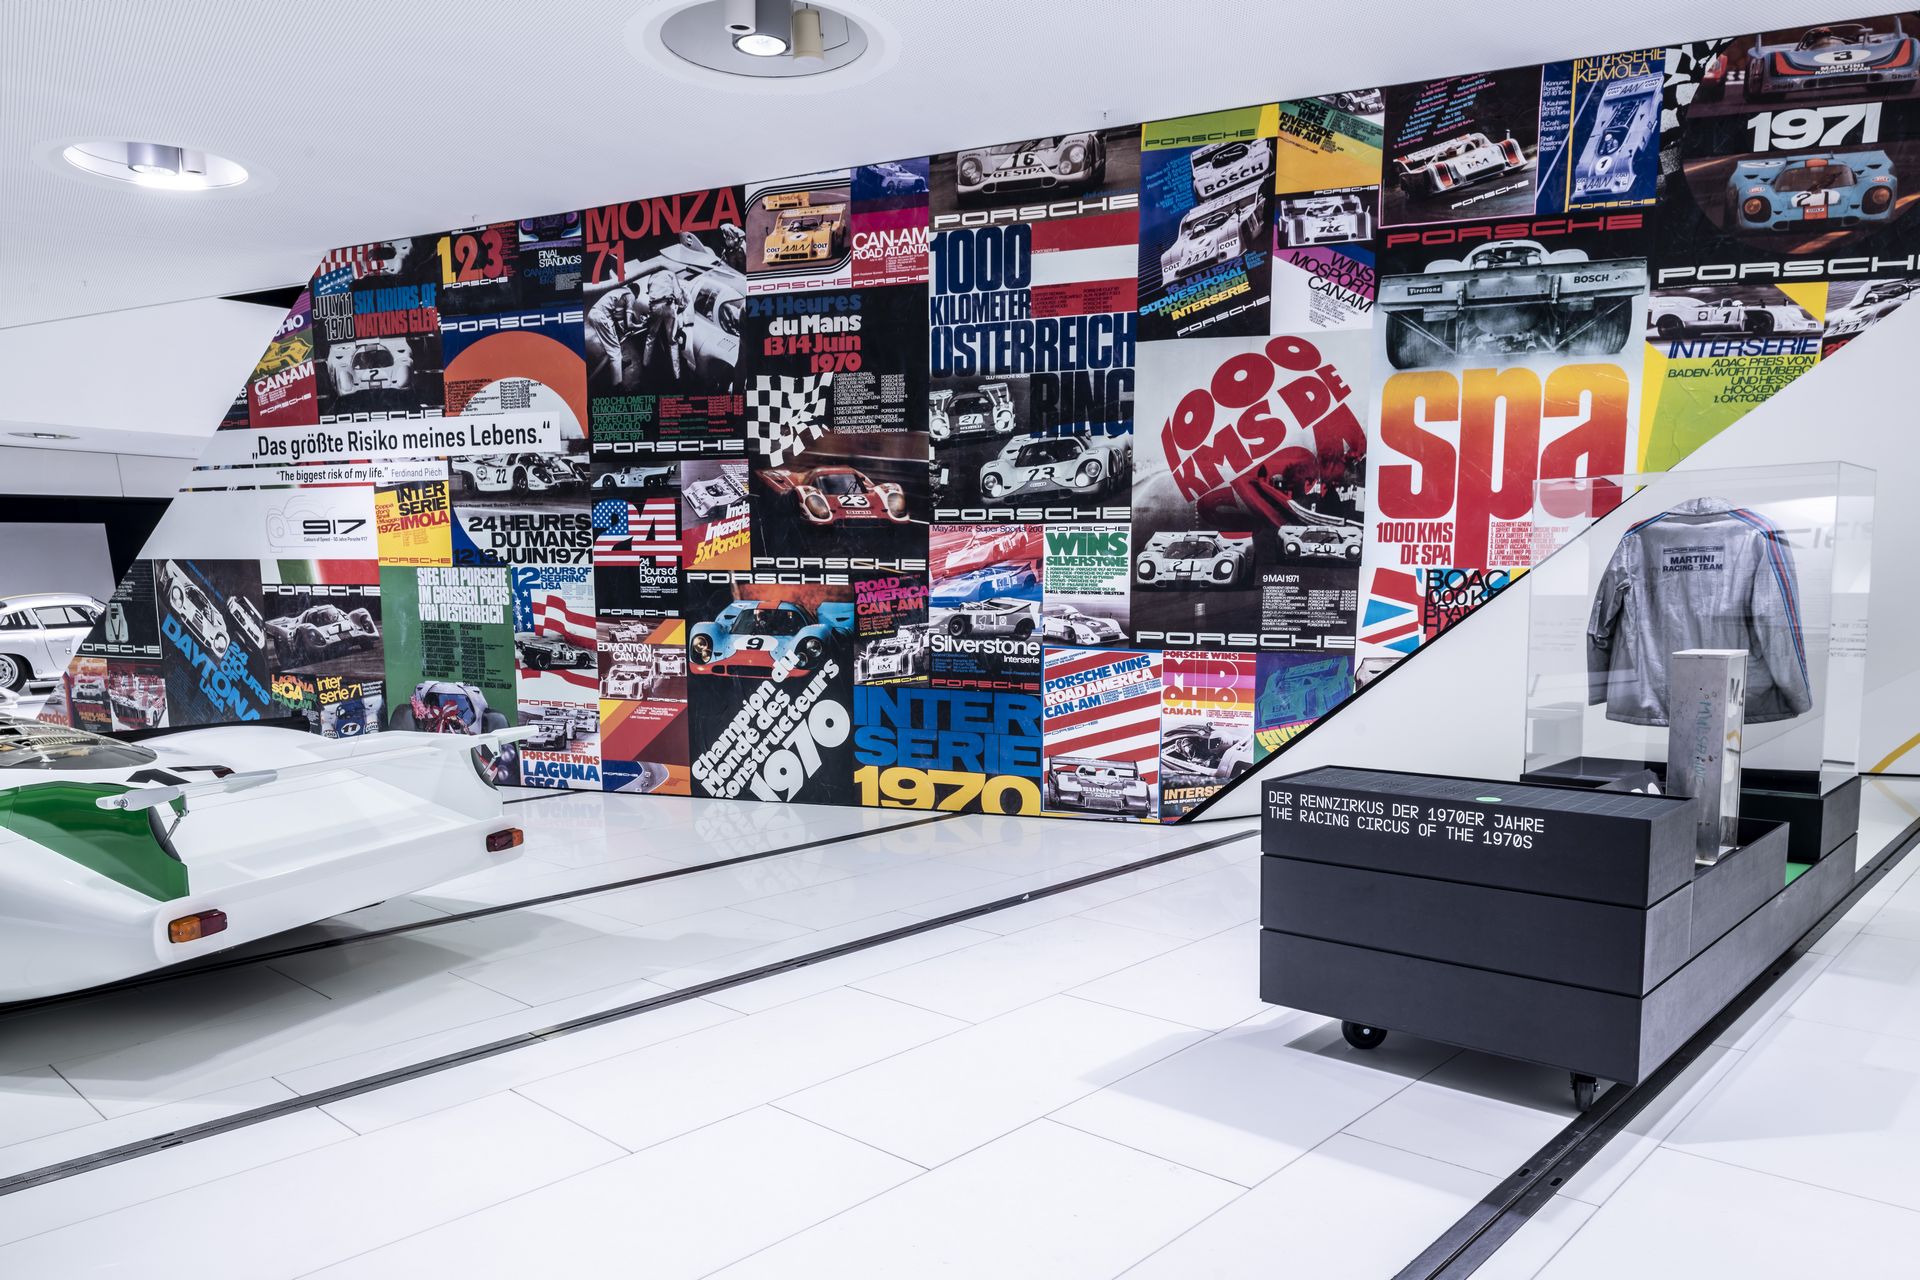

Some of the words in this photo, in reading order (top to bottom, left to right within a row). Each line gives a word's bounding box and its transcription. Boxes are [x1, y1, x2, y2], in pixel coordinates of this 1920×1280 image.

[1577, 63, 1650, 83] KEIMOLA
[1279, 112, 1335, 139] RIVERSIDE
[1747, 102, 1882, 152] 1971
[1145, 129, 1255, 147] PORSCHE
[993, 167, 1046, 178] GESIPA
[1205, 163, 1264, 195] BOSCH
[1452, 180, 1529, 209] PORSCHE
[1569, 199, 1656, 210] PORSCHE
[585, 187, 742, 243] MONZA
[934, 194, 1138, 229] PORSCHE
[1387, 214, 1643, 248] PORSCHE
[539, 250, 560, 259] FINAL
[853, 248, 883, 260] ROAD
[885, 244, 929, 257] ATLANTA
[930, 224, 1031, 295] 1000
[1164, 262, 1181, 273] COLT
[1220, 239, 1238, 250] COLT
[1290, 251, 1375, 296] MOSPORT
[1332, 253, 1375, 280] WINS
[748, 278, 851, 292] PORSCHE
[1574, 274, 1609, 284] BOSCH
[376, 285, 419, 313] HOURS
[1159, 273, 1248, 317] HOCKENHEIM
[1409, 286, 1442, 295] Firestone
[931, 289, 1031, 326] KILOMETER
[1172, 282, 1250, 320] INTERSERIE
[354, 310, 408, 337] WATKINS
[409, 307, 438, 332] GLEN
[441, 311, 583, 334] PORSCHE
[801, 315, 862, 334] Mans
[1177, 295, 1270, 337] PORSCHE
[325, 316, 354, 340] 1970
[1668, 337, 1822, 358] INTERSERIE
[811, 353, 862, 373] 1970
[1712, 358, 1747, 367] ADAC
[1749, 357, 1784, 365] PREIS
[611, 395, 656, 404] CHILOMETRI
[630, 404, 652, 412] ITALIA
[1030, 368, 1135, 438] RING
[593, 423, 640, 431] CARACCIOLO
[291, 433, 343, 460] größte
[348, 429, 398, 451] Risiko
[402, 427, 465, 449] meines
[593, 440, 744, 453] PORSCHE
[1378, 364, 1630, 569] spa
[296, 469, 327, 485] biggest
[328, 469, 342, 479] risk
[345, 469, 354, 478] of
[355, 470, 367, 481] my
[392, 469, 423, 477] Ferdinand
[396, 482, 445, 503] INTER
[399, 497, 447, 516] SERIE
[726, 501, 749, 519] Imola
[934, 508, 1131, 520] PORSCHE
[303, 519, 366, 534] 917
[377, 523, 400, 534] 1972
[400, 511, 449, 530] IMOLA
[501, 514, 591, 531] HEURES
[705, 516, 750, 541] Interserie
[526, 531, 592, 547] MANS
[1377, 522, 1416, 543] 1000
[1417, 522, 1453, 543] KMS
[1045, 532, 1128, 556] WINS
[753, 557, 926, 570] PORSCHE
[1046, 556, 1128, 567] SILVERSTONE
[1401, 545, 1420, 564] DE
[1422, 544, 1451, 565] SPA
[1670, 555, 1715, 564] MARTINI
[417, 568, 439, 586] SIEG
[461, 568, 507, 586] PORSCHE
[540, 567, 573, 575] HOURS
[575, 567, 592, 575] OF
[640, 567, 666, 575] Hours
[640, 575, 677, 586] Daytona
[687, 573, 849, 585] PORSCHE
[263, 586, 381, 596] PORSCHE
[855, 577, 899, 593] ROAD
[857, 585, 929, 604] AMERICA
[433, 586, 478, 604] GROSSEN
[480, 587, 509, 605] PREIS
[440, 604, 504, 624] OESTERREICH
[598, 643, 651, 652] EDMONTON
[931, 635, 1040, 655] Silverstone
[1137, 631, 1355, 648] PORSCHE
[1212, 652, 1239, 660] WINS
[224, 652, 270, 705] HOURS
[317, 676, 342, 691] inter
[1045, 665, 1111, 692] PORSCHE
[1112, 656, 1150, 673] WINS
[931, 679, 1039, 690] PORSCHE
[1046, 688, 1085, 705] ROAD
[1086, 669, 1154, 692] AMERICA
[200, 679, 224, 713] USA
[320, 687, 348, 704] serie
[853, 686, 1041, 737] INTER
[692, 680, 776, 781] Champion
[572, 754, 599, 765] WINS
[750, 700, 850, 803] 1970
[854, 726, 1040, 777] SERIE
[523, 760, 600, 782] LAGUNA
[701, 728, 760, 796] Monde
[854, 766, 1041, 816] 1970
[1269, 791, 1293, 805] DER
[1300, 794, 1384, 815] RENNZIRKUS
[1393, 804, 1419, 819] DER
[1428, 808, 1485, 826] 1970ER
[1494, 814, 1544, 833] JAHRE
[1269, 806, 1293, 821] THE
[1300, 810, 1349, 828] RACING
[1357, 817, 1410, 834] CIRCUS
[1418, 824, 1437, 837] OF
[1446, 826, 1473, 842] THE
[1483, 831, 1532, 849] 1970S
